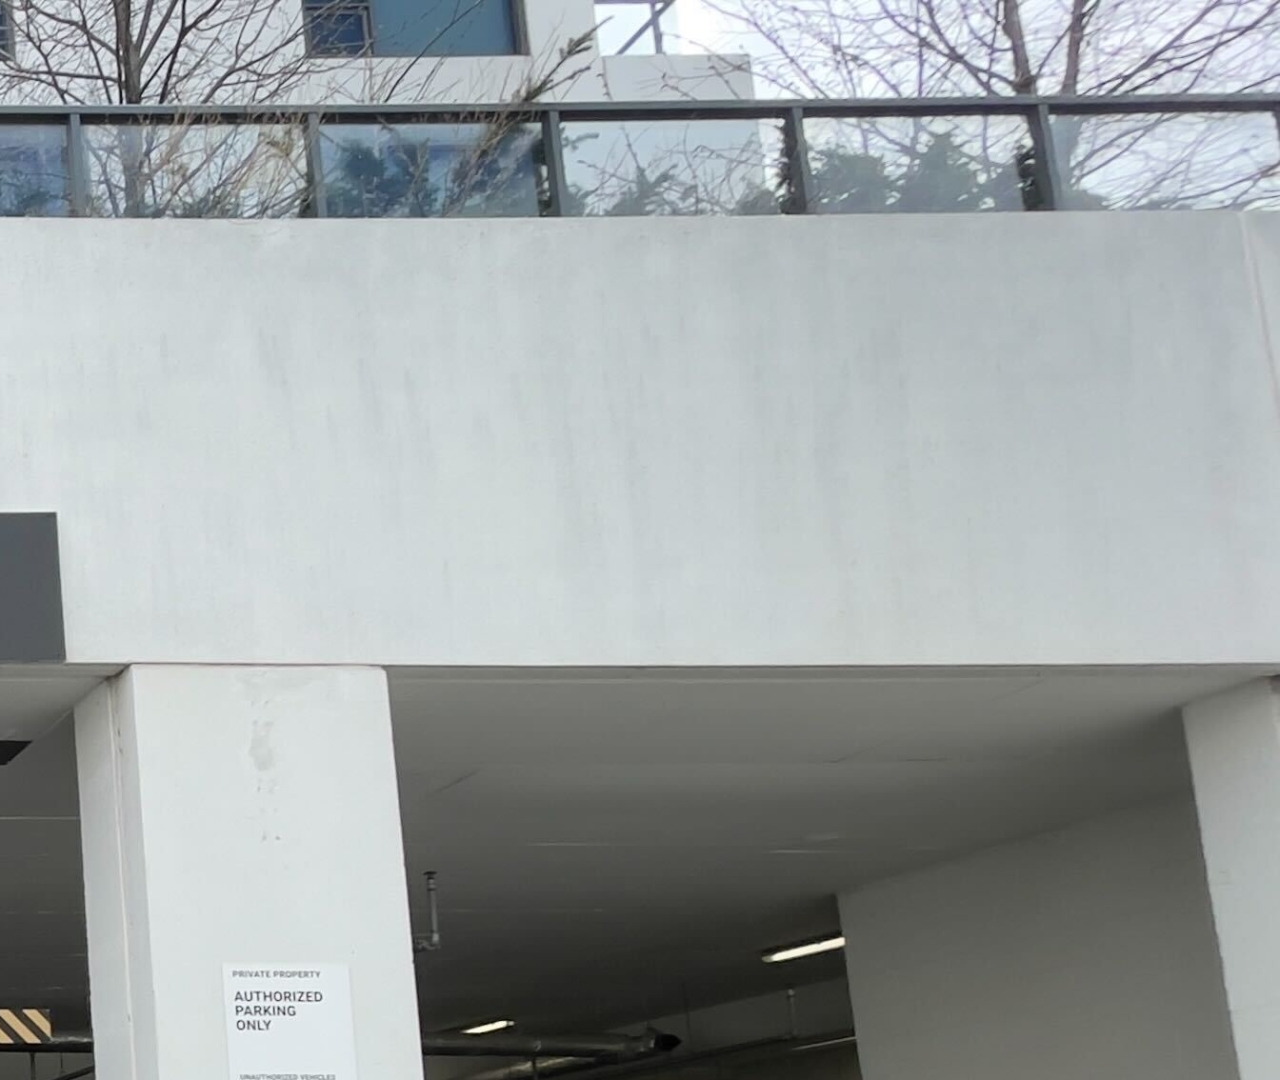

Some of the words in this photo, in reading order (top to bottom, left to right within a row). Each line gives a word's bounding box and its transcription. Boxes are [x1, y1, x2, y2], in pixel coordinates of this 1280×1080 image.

[232, 970, 271, 979] PRIVATE
[273, 970, 321, 979] PROPERTY
[234, 990, 324, 1003] AUTHORIZED
[235, 1004, 297, 1017] PARKING
[236, 1019, 272, 1032] ONLY
